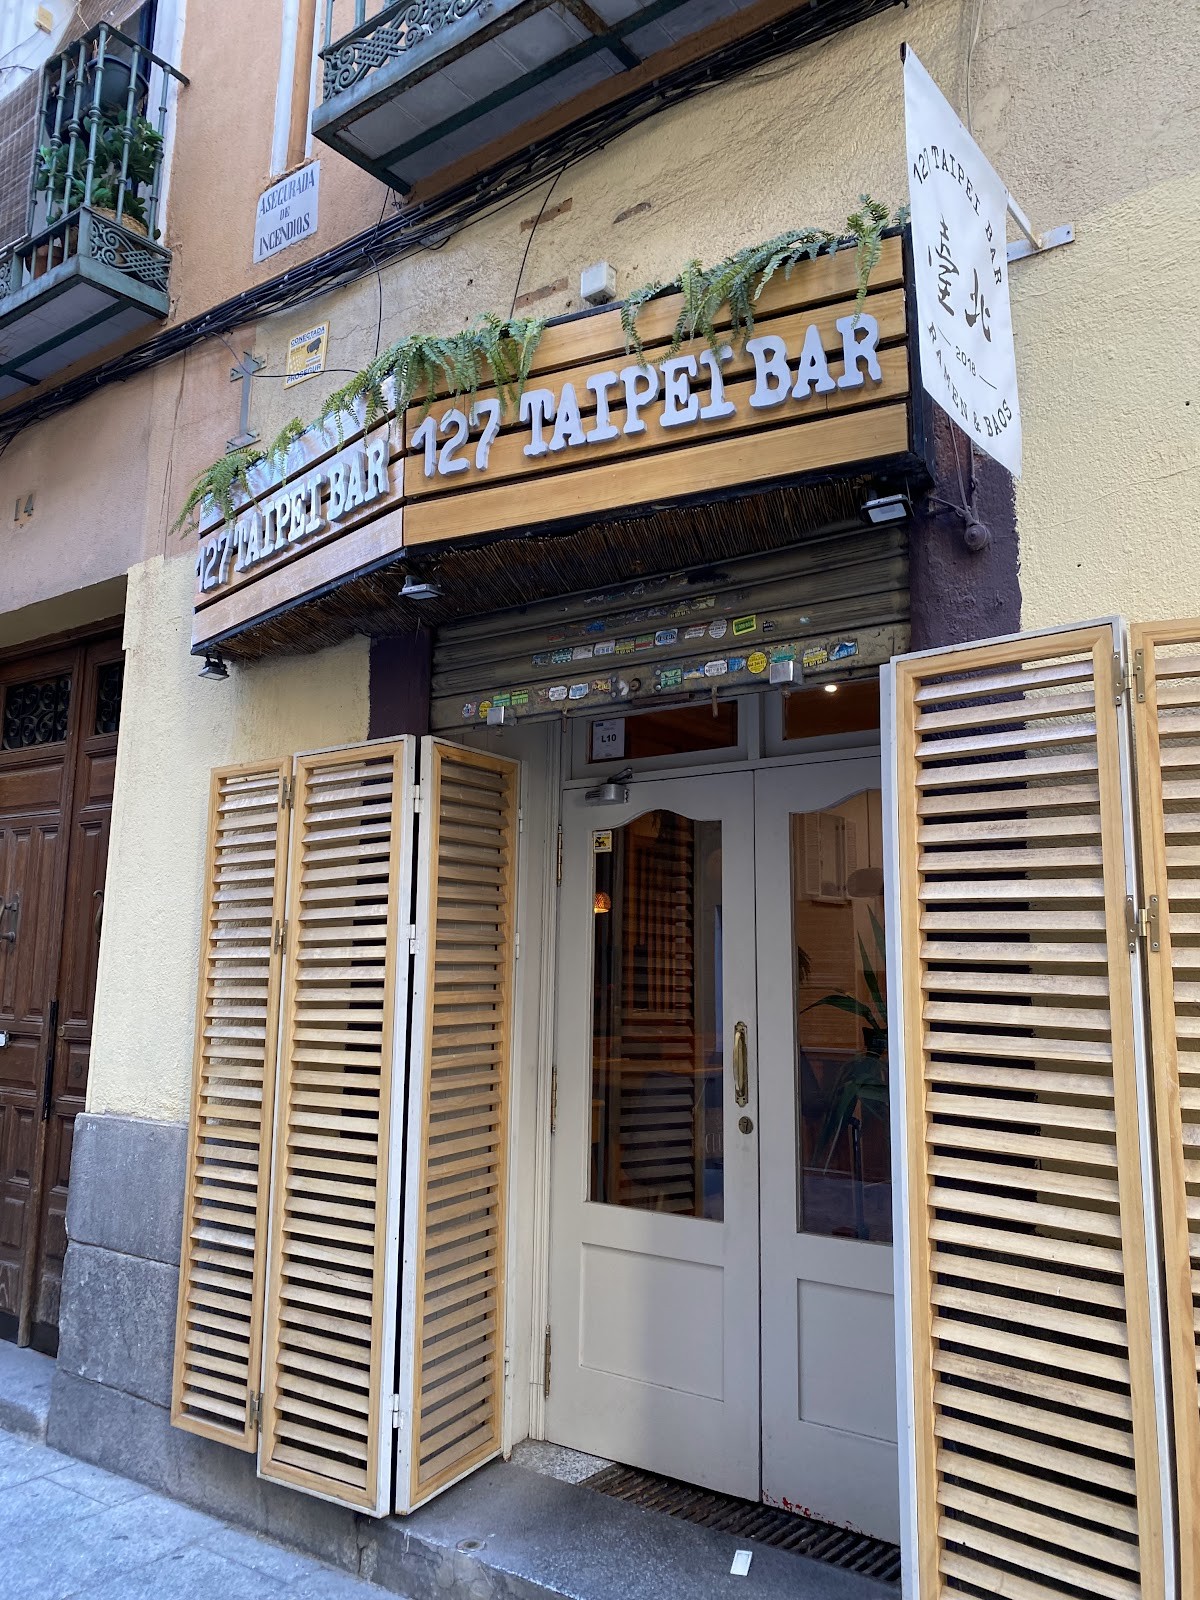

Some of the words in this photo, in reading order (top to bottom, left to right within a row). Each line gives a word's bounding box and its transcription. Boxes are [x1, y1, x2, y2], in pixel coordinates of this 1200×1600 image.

[259, 169, 315, 216] ASEGURADA
[258, 212, 310, 256] INCENDIOS
[279, 206, 291, 221] DE
[931, 145, 981, 216] TAIPEI
[985, 220, 1002, 285] BAR
[955, 345, 977, 377] 2018
[409, 398, 501, 479] 127
[519, 344, 737, 458] TAIPEI
[745, 312, 883, 410] BAR
[984, 399, 1013, 438] BAOS
[13, 493, 34, 522] 14
[194, 529, 233, 593] 127
[234, 473, 327, 573] TAIPEI
[327, 438, 390, 521] BAR
[601, 733, 617, 743] L10
